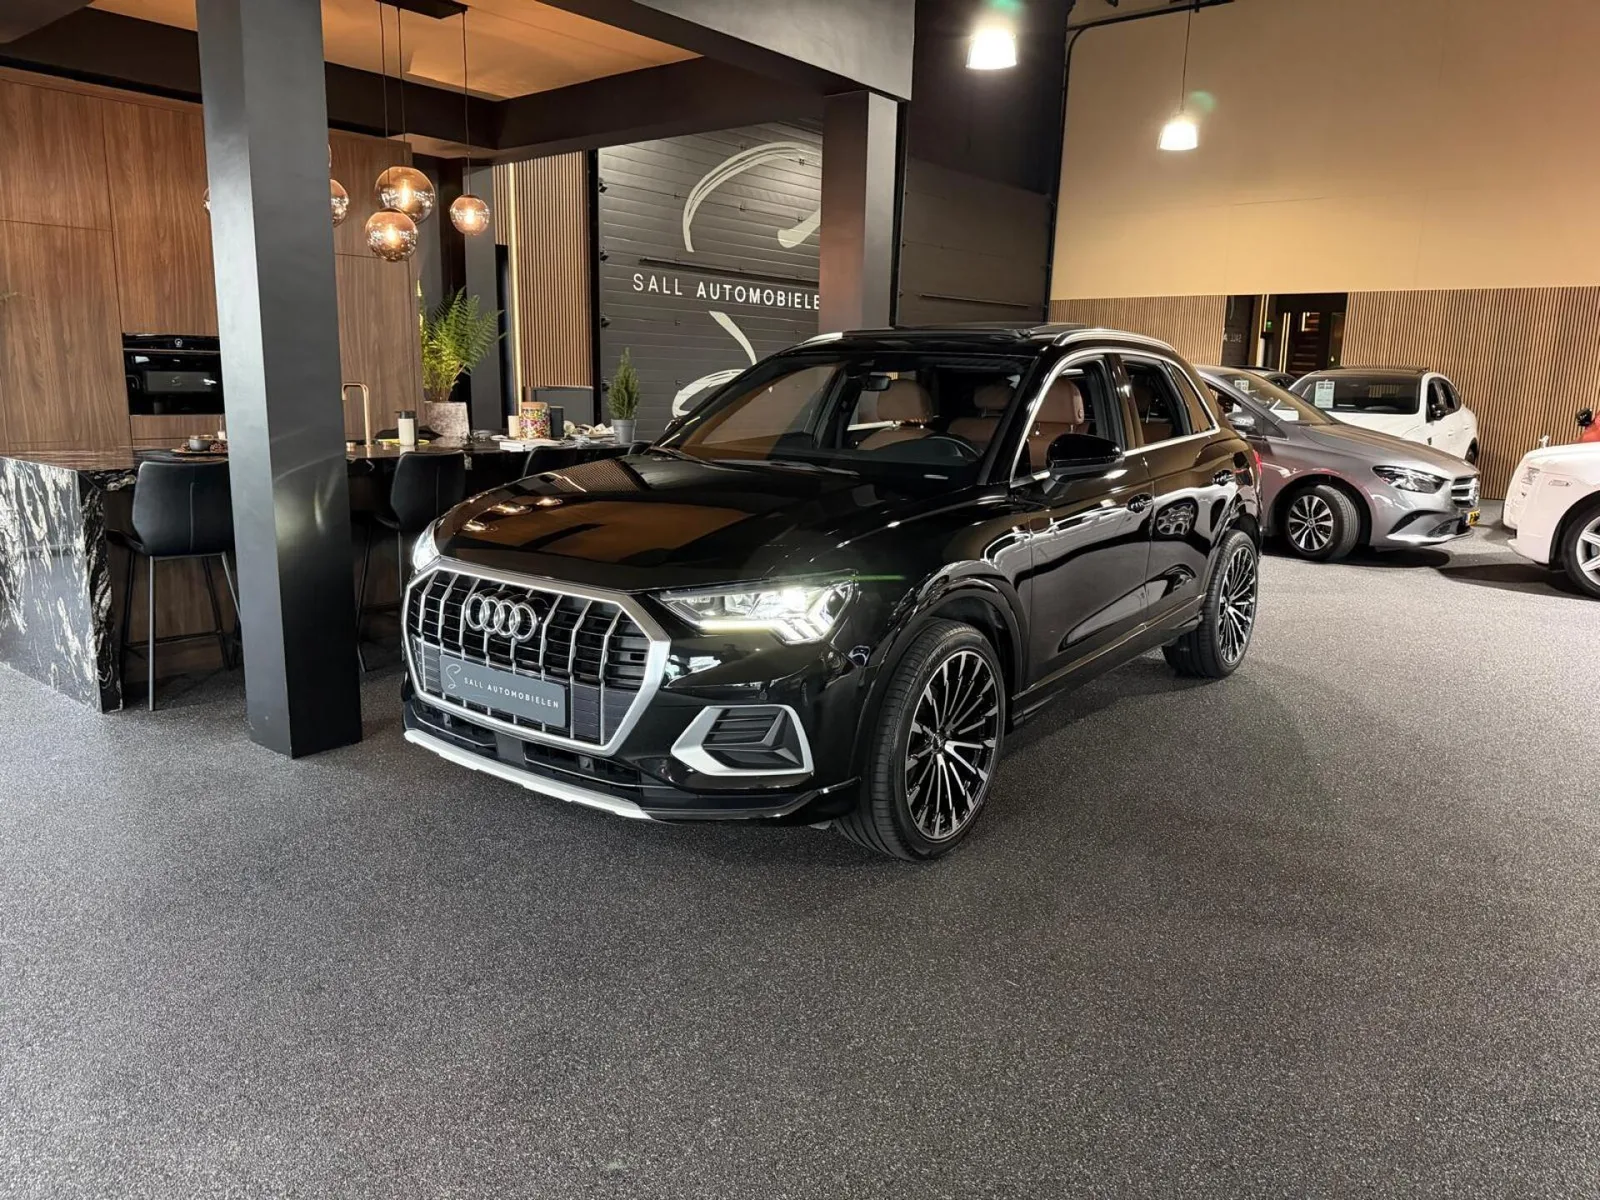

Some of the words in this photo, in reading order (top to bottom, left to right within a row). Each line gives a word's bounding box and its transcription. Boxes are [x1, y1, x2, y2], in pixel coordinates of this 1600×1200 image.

[632, 273, 683, 296] SALL
[464, 677, 484, 689] SALL
[487, 684, 559, 709] AUTOMOBIELEN
